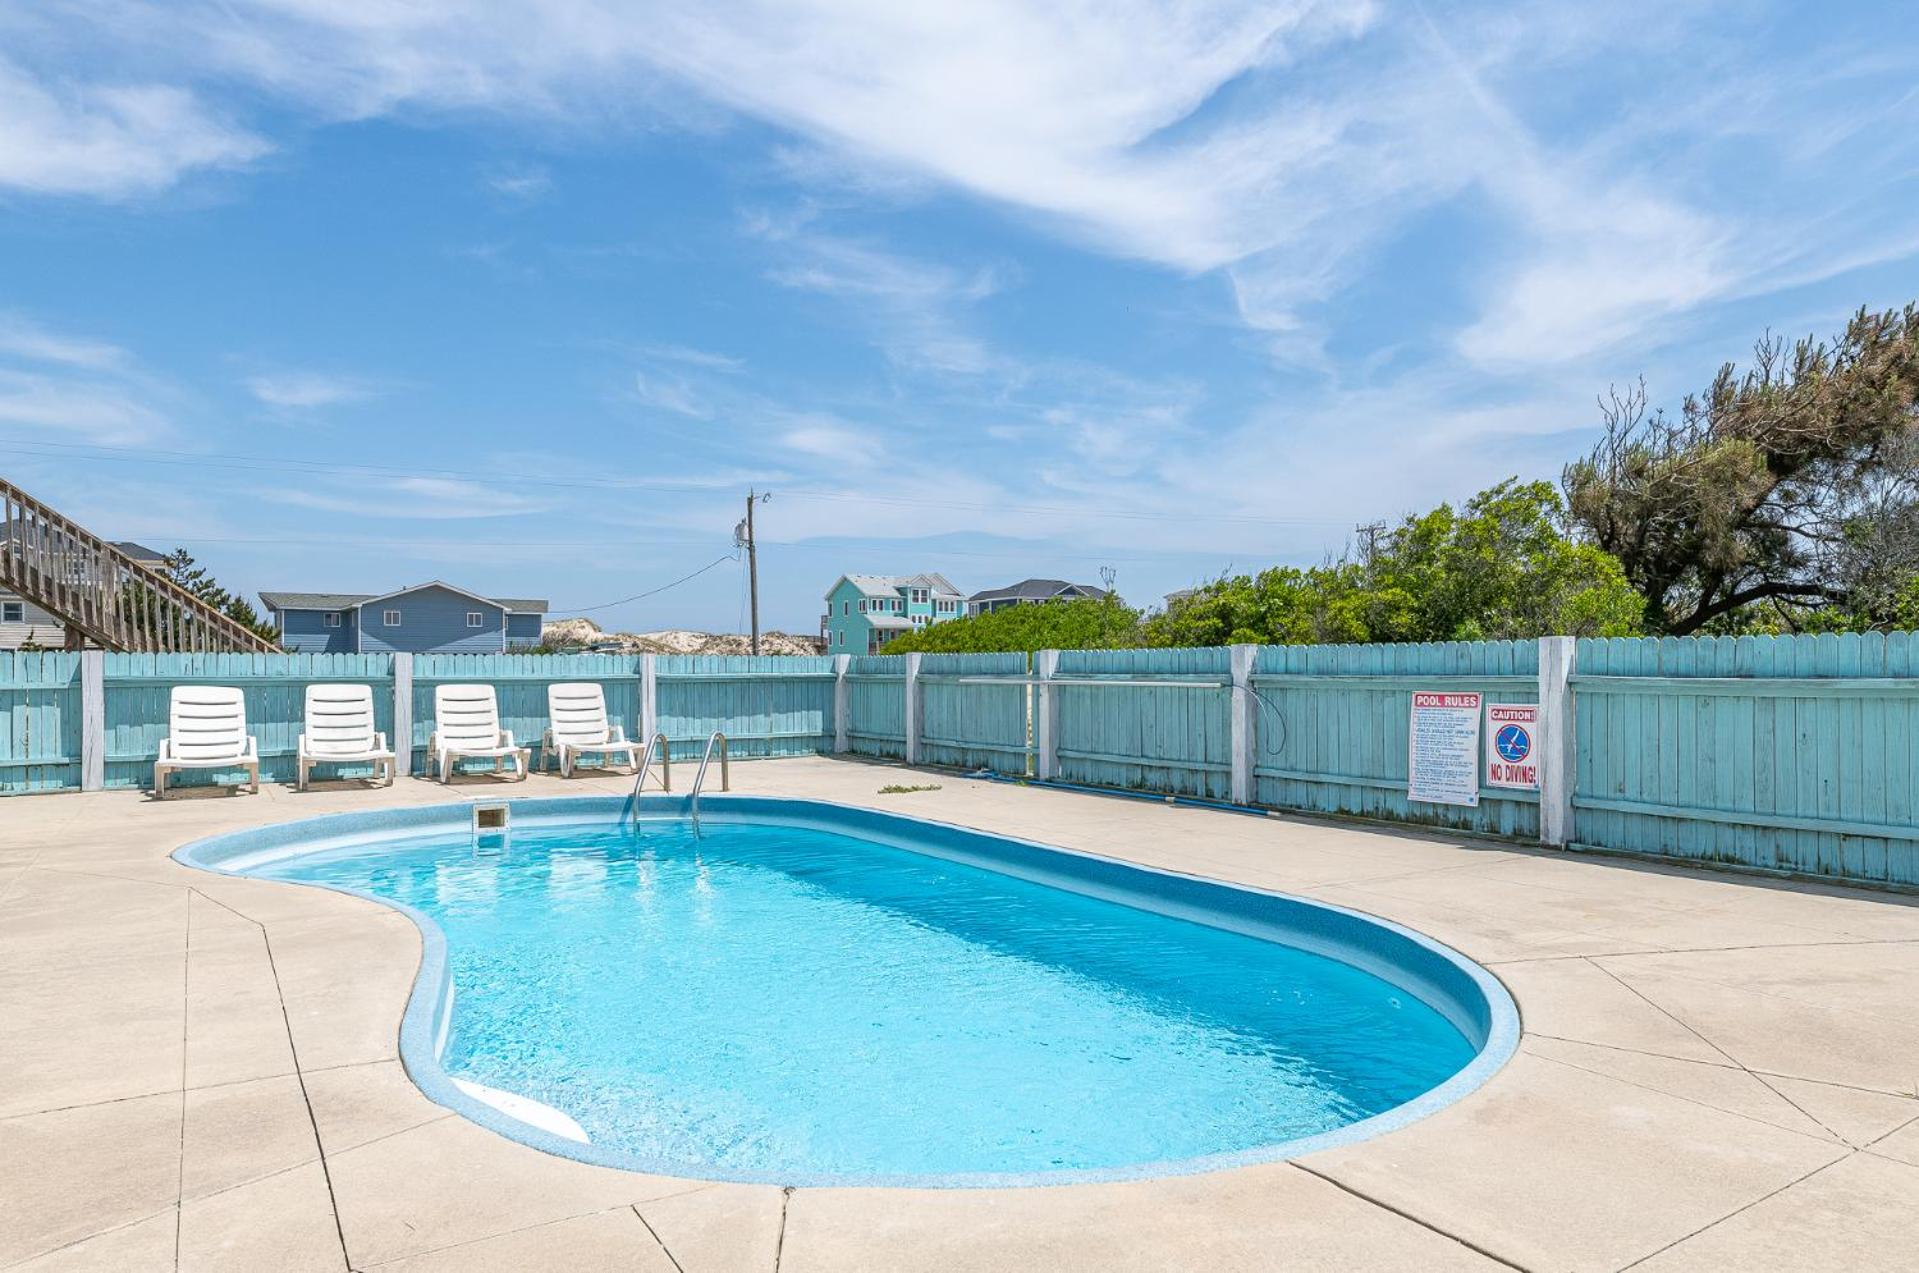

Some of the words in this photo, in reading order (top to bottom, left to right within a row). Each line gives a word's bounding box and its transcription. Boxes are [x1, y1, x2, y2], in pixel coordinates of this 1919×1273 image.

[1416, 695, 1441, 706] POOL
[1444, 696, 1477, 707] RULES
[1491, 710, 1536, 721] CAUTION!
[1491, 764, 1503, 781] NO
[1505, 765, 1536, 784] DIVING!
